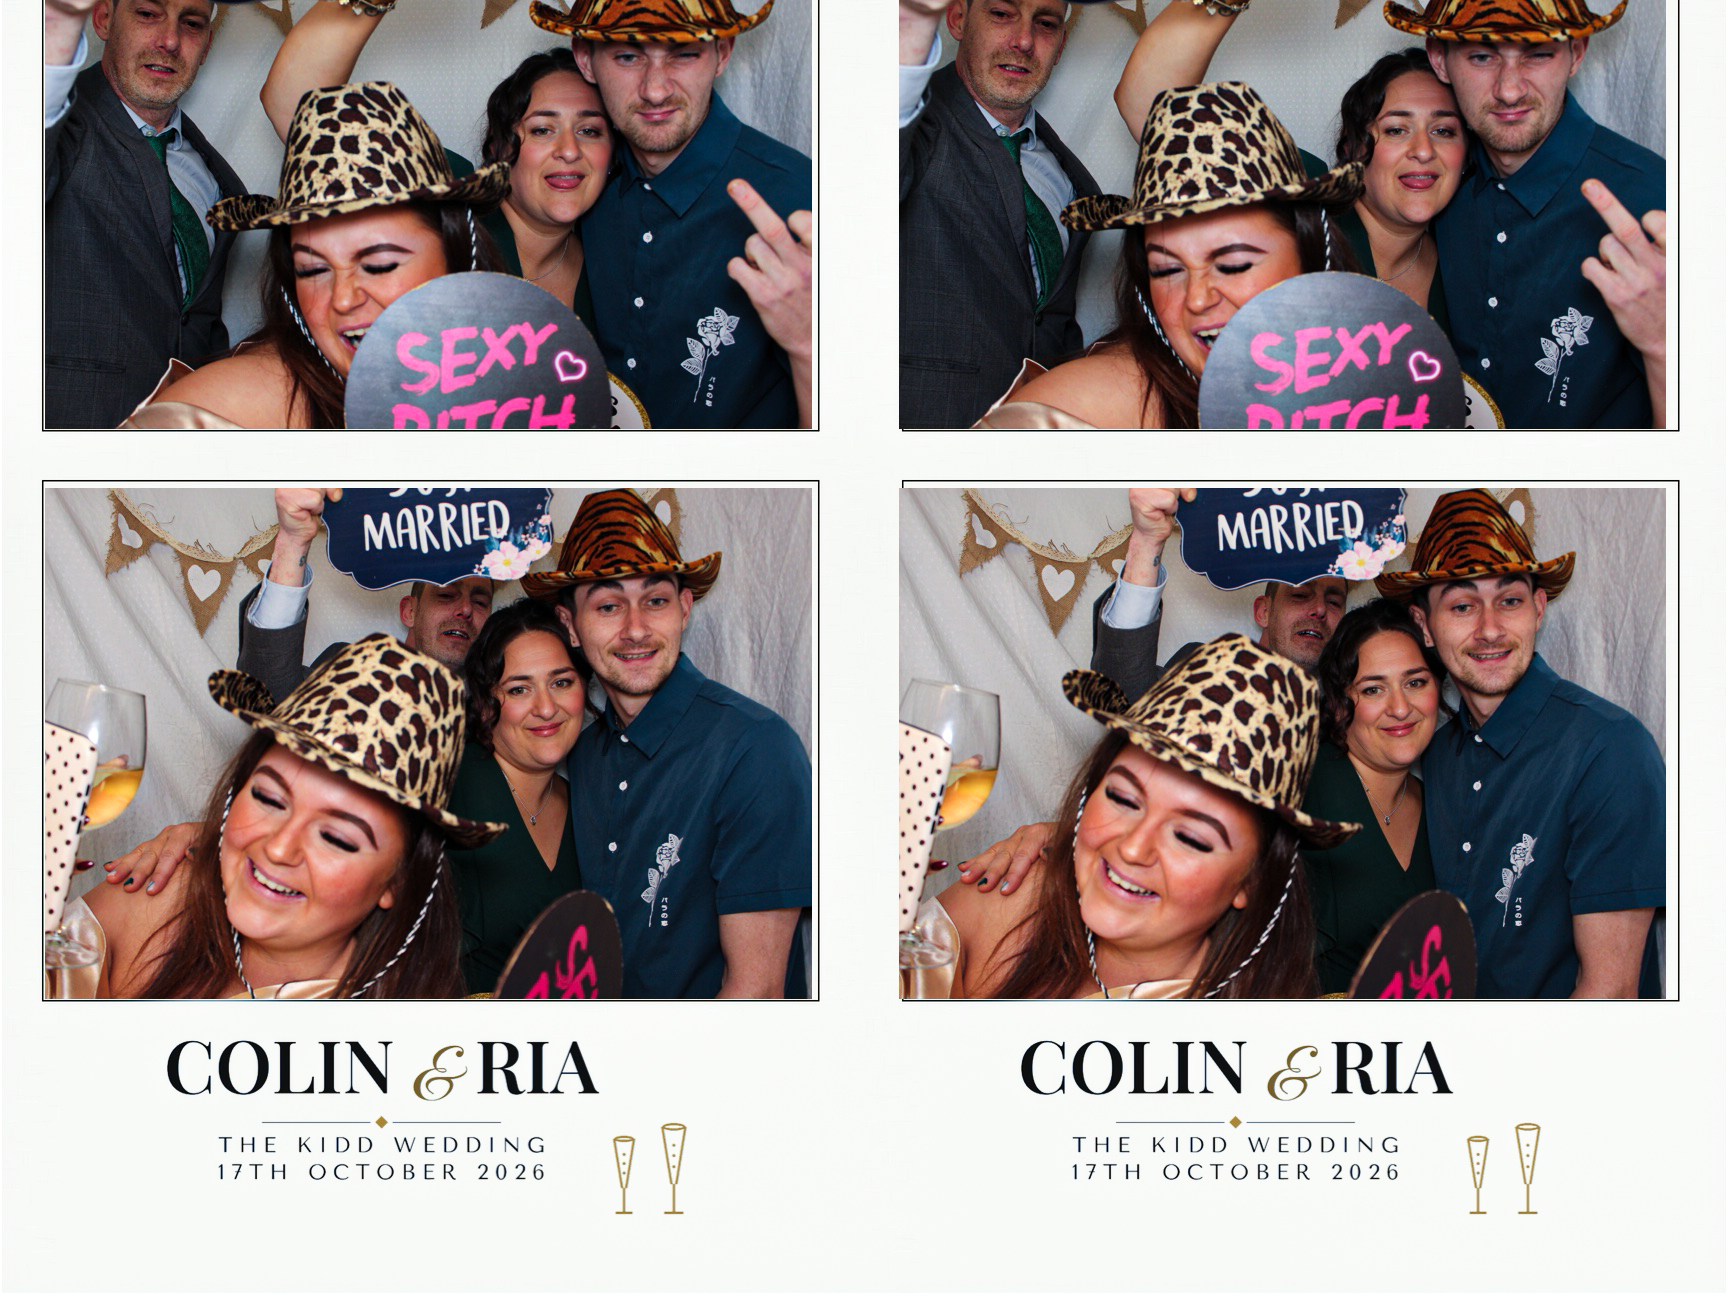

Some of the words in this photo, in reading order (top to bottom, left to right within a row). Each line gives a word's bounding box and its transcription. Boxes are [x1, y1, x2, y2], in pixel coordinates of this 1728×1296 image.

[396, 321, 559, 396] SEXY
[1250, 321, 1413, 396] SEXY
[363, 500, 510, 554] MARRIED
[1217, 500, 1364, 554] MARRIED
